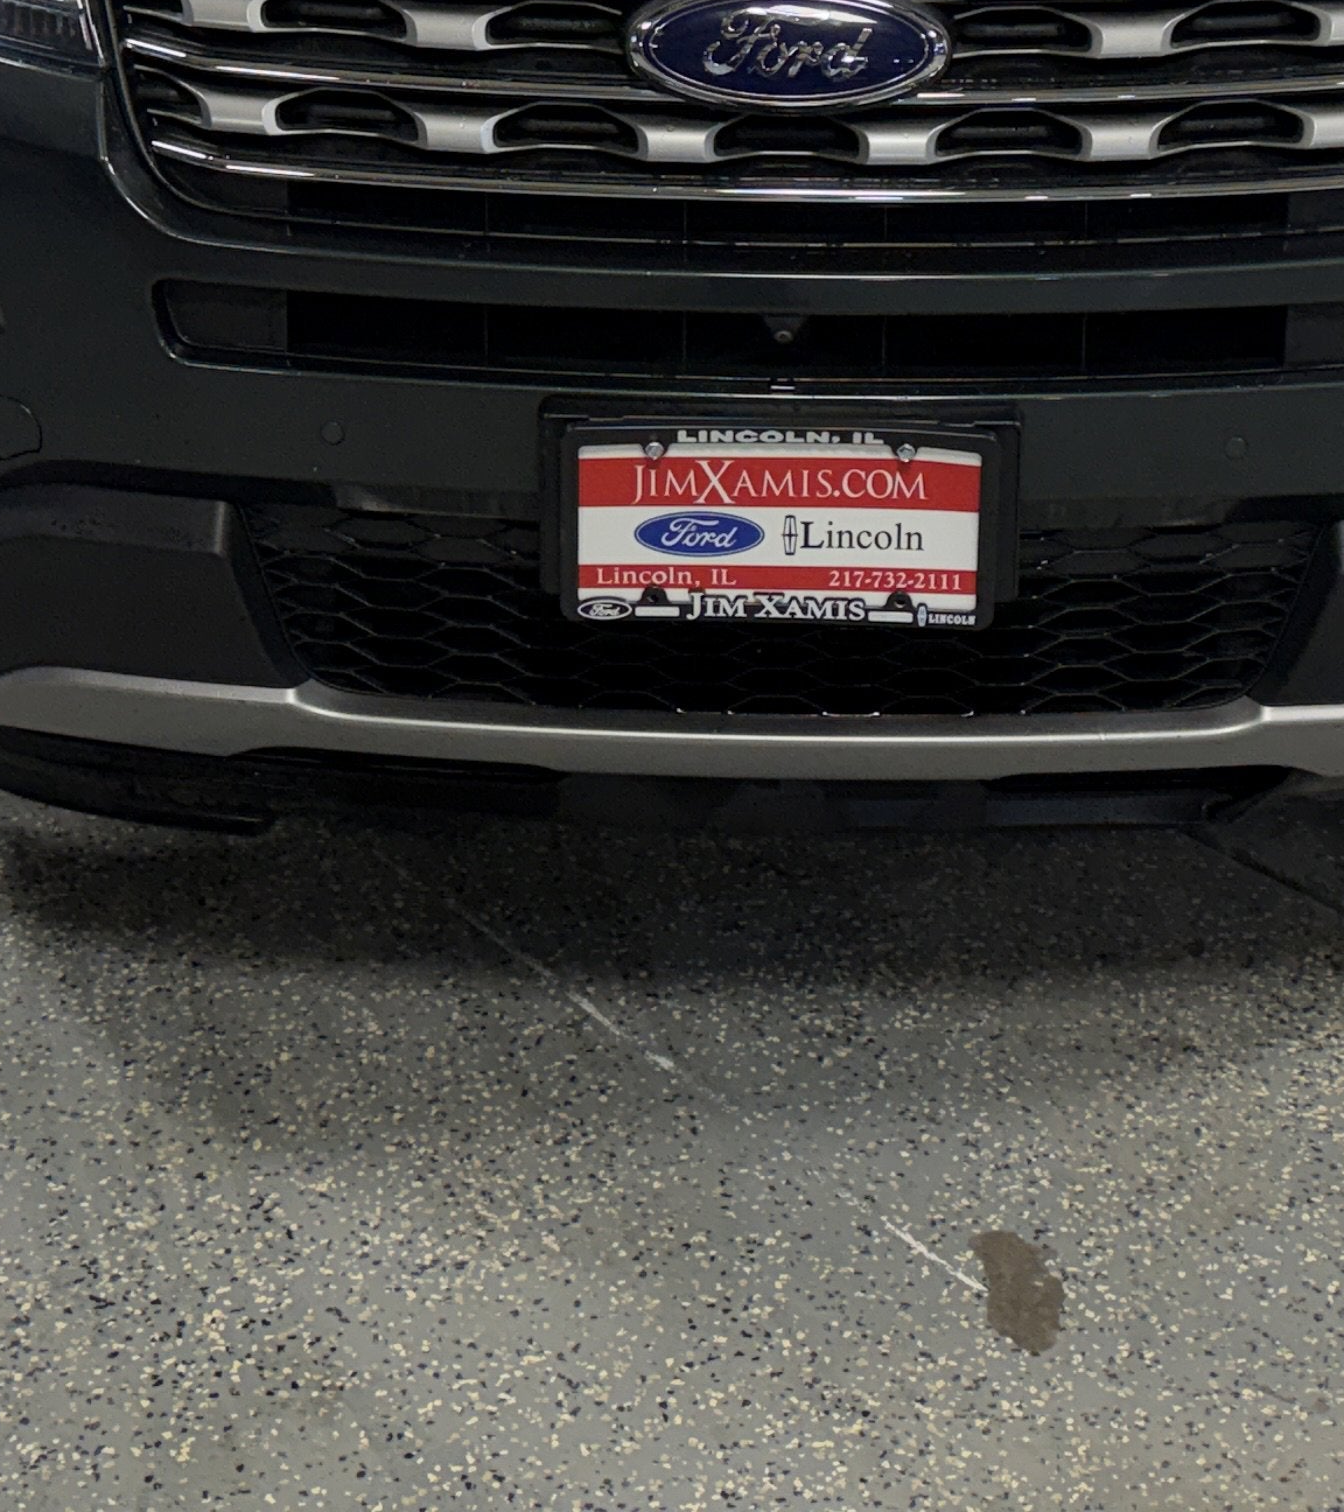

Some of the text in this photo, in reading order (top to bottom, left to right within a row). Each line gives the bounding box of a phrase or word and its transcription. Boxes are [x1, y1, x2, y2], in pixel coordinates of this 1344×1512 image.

[703, 4, 878, 80] Ford
[853, 432, 884, 445] IL
[661, 517, 737, 548] Ford
[800, 521, 925, 551] Lincoln
[597, 567, 737, 587] Lincoln, IL
[829, 570, 961, 590] 217-732-2111
[686, 592, 866, 621] JIM XAMIS
[928, 614, 976, 625] LINCOLN
